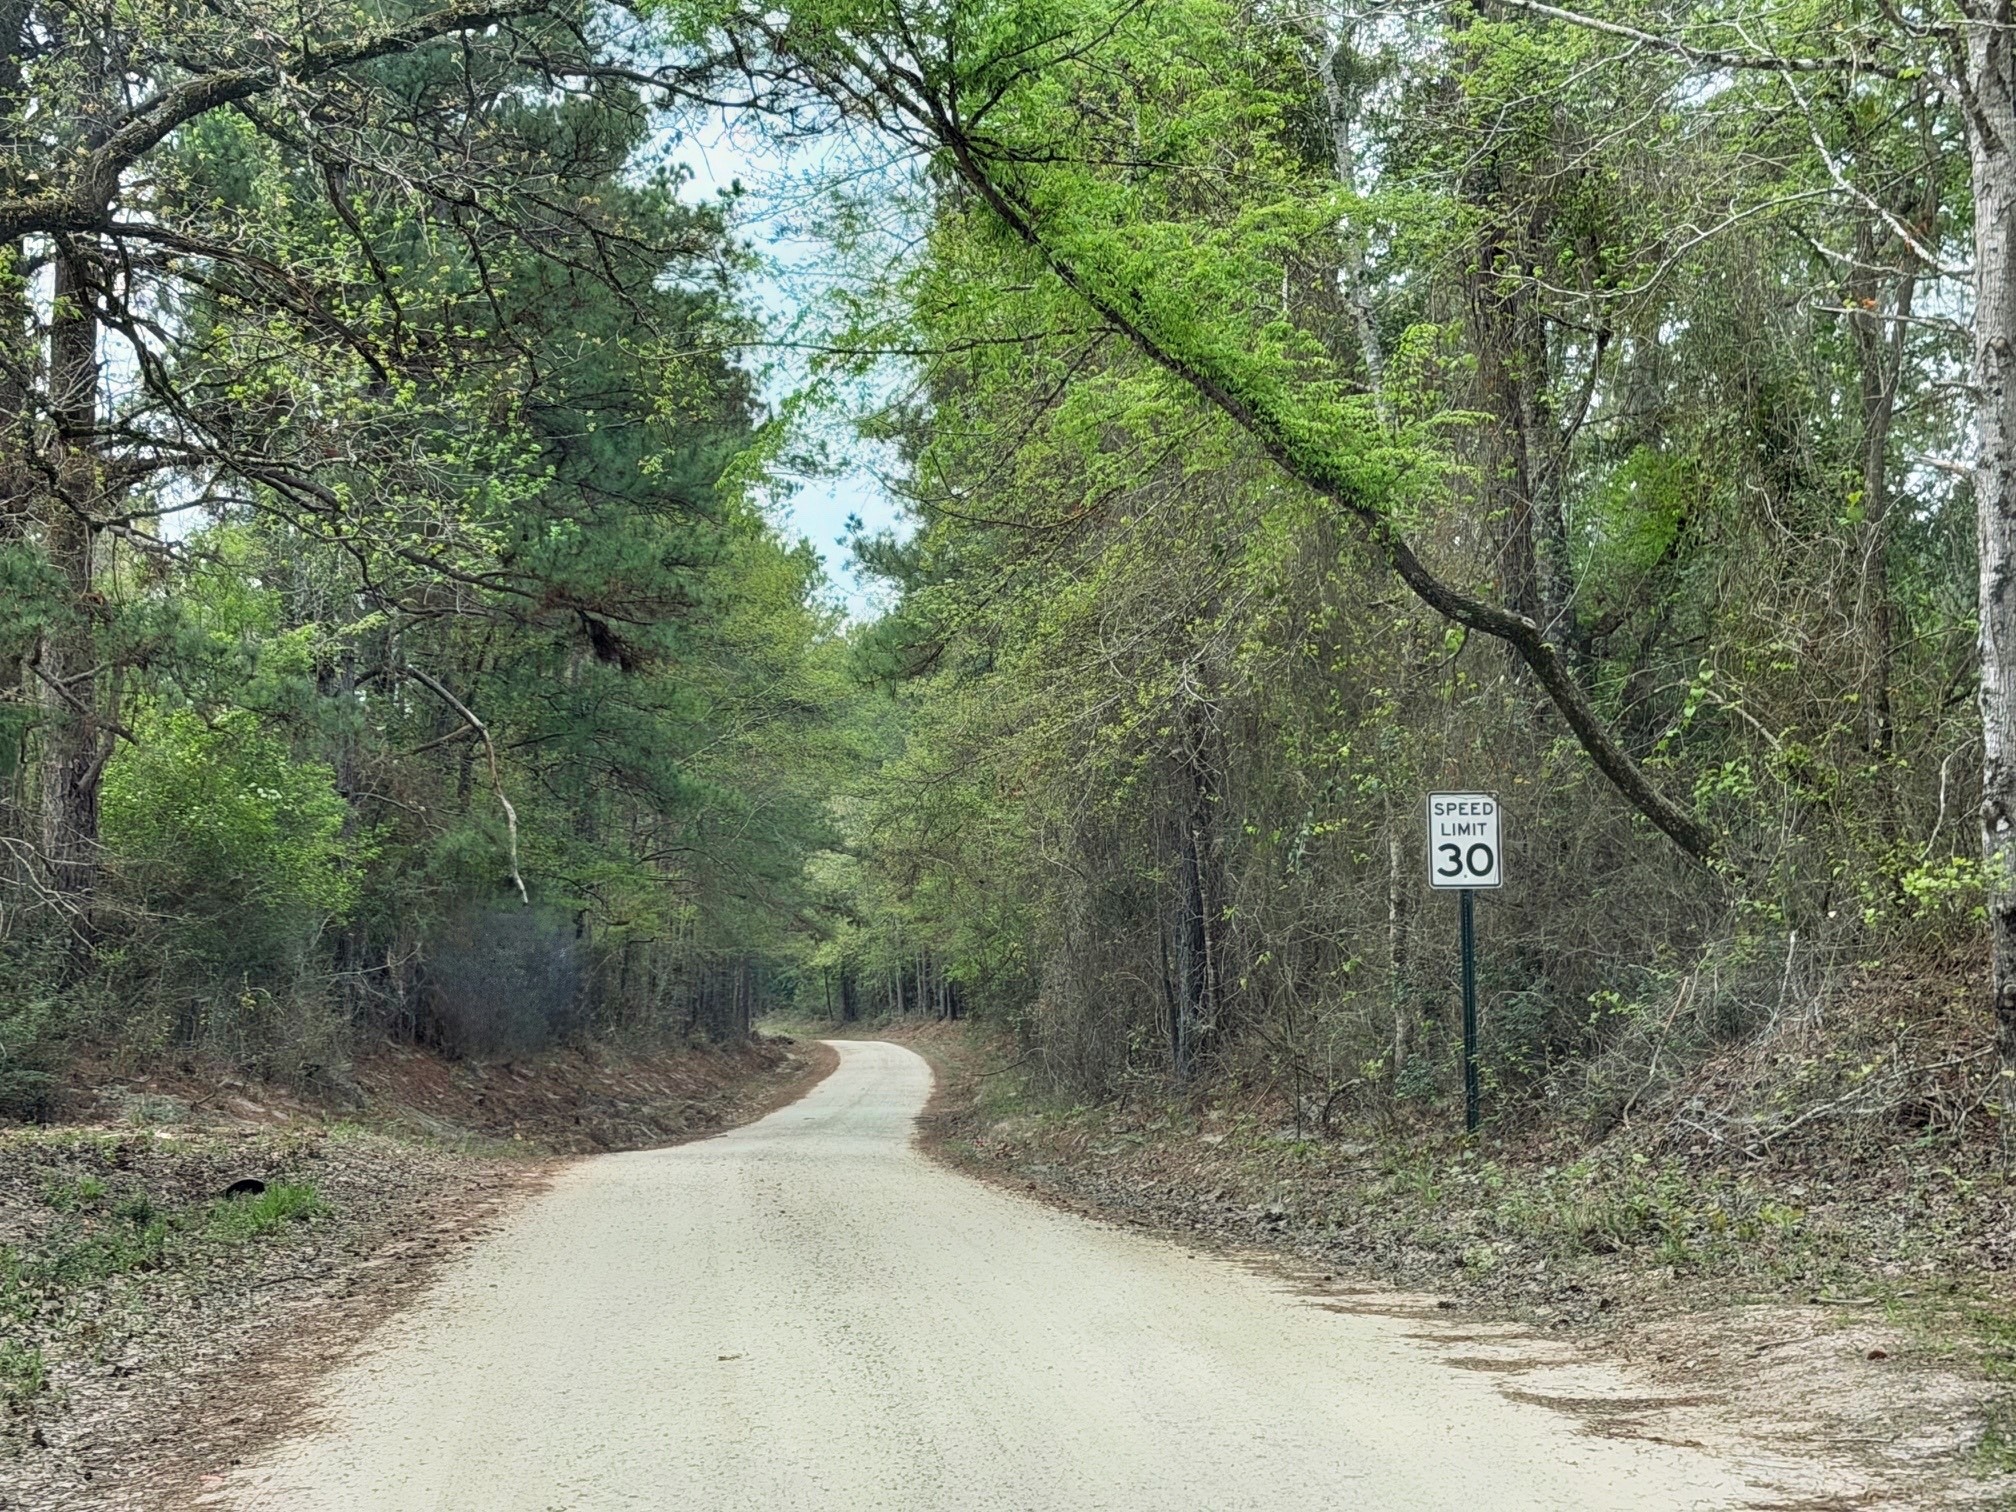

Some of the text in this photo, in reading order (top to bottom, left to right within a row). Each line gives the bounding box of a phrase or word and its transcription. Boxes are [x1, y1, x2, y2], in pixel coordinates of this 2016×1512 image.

[1434, 802, 1494, 816] SPEED
[1441, 822, 1487, 836] LIMIT
[1437, 843, 1494, 877] 30
